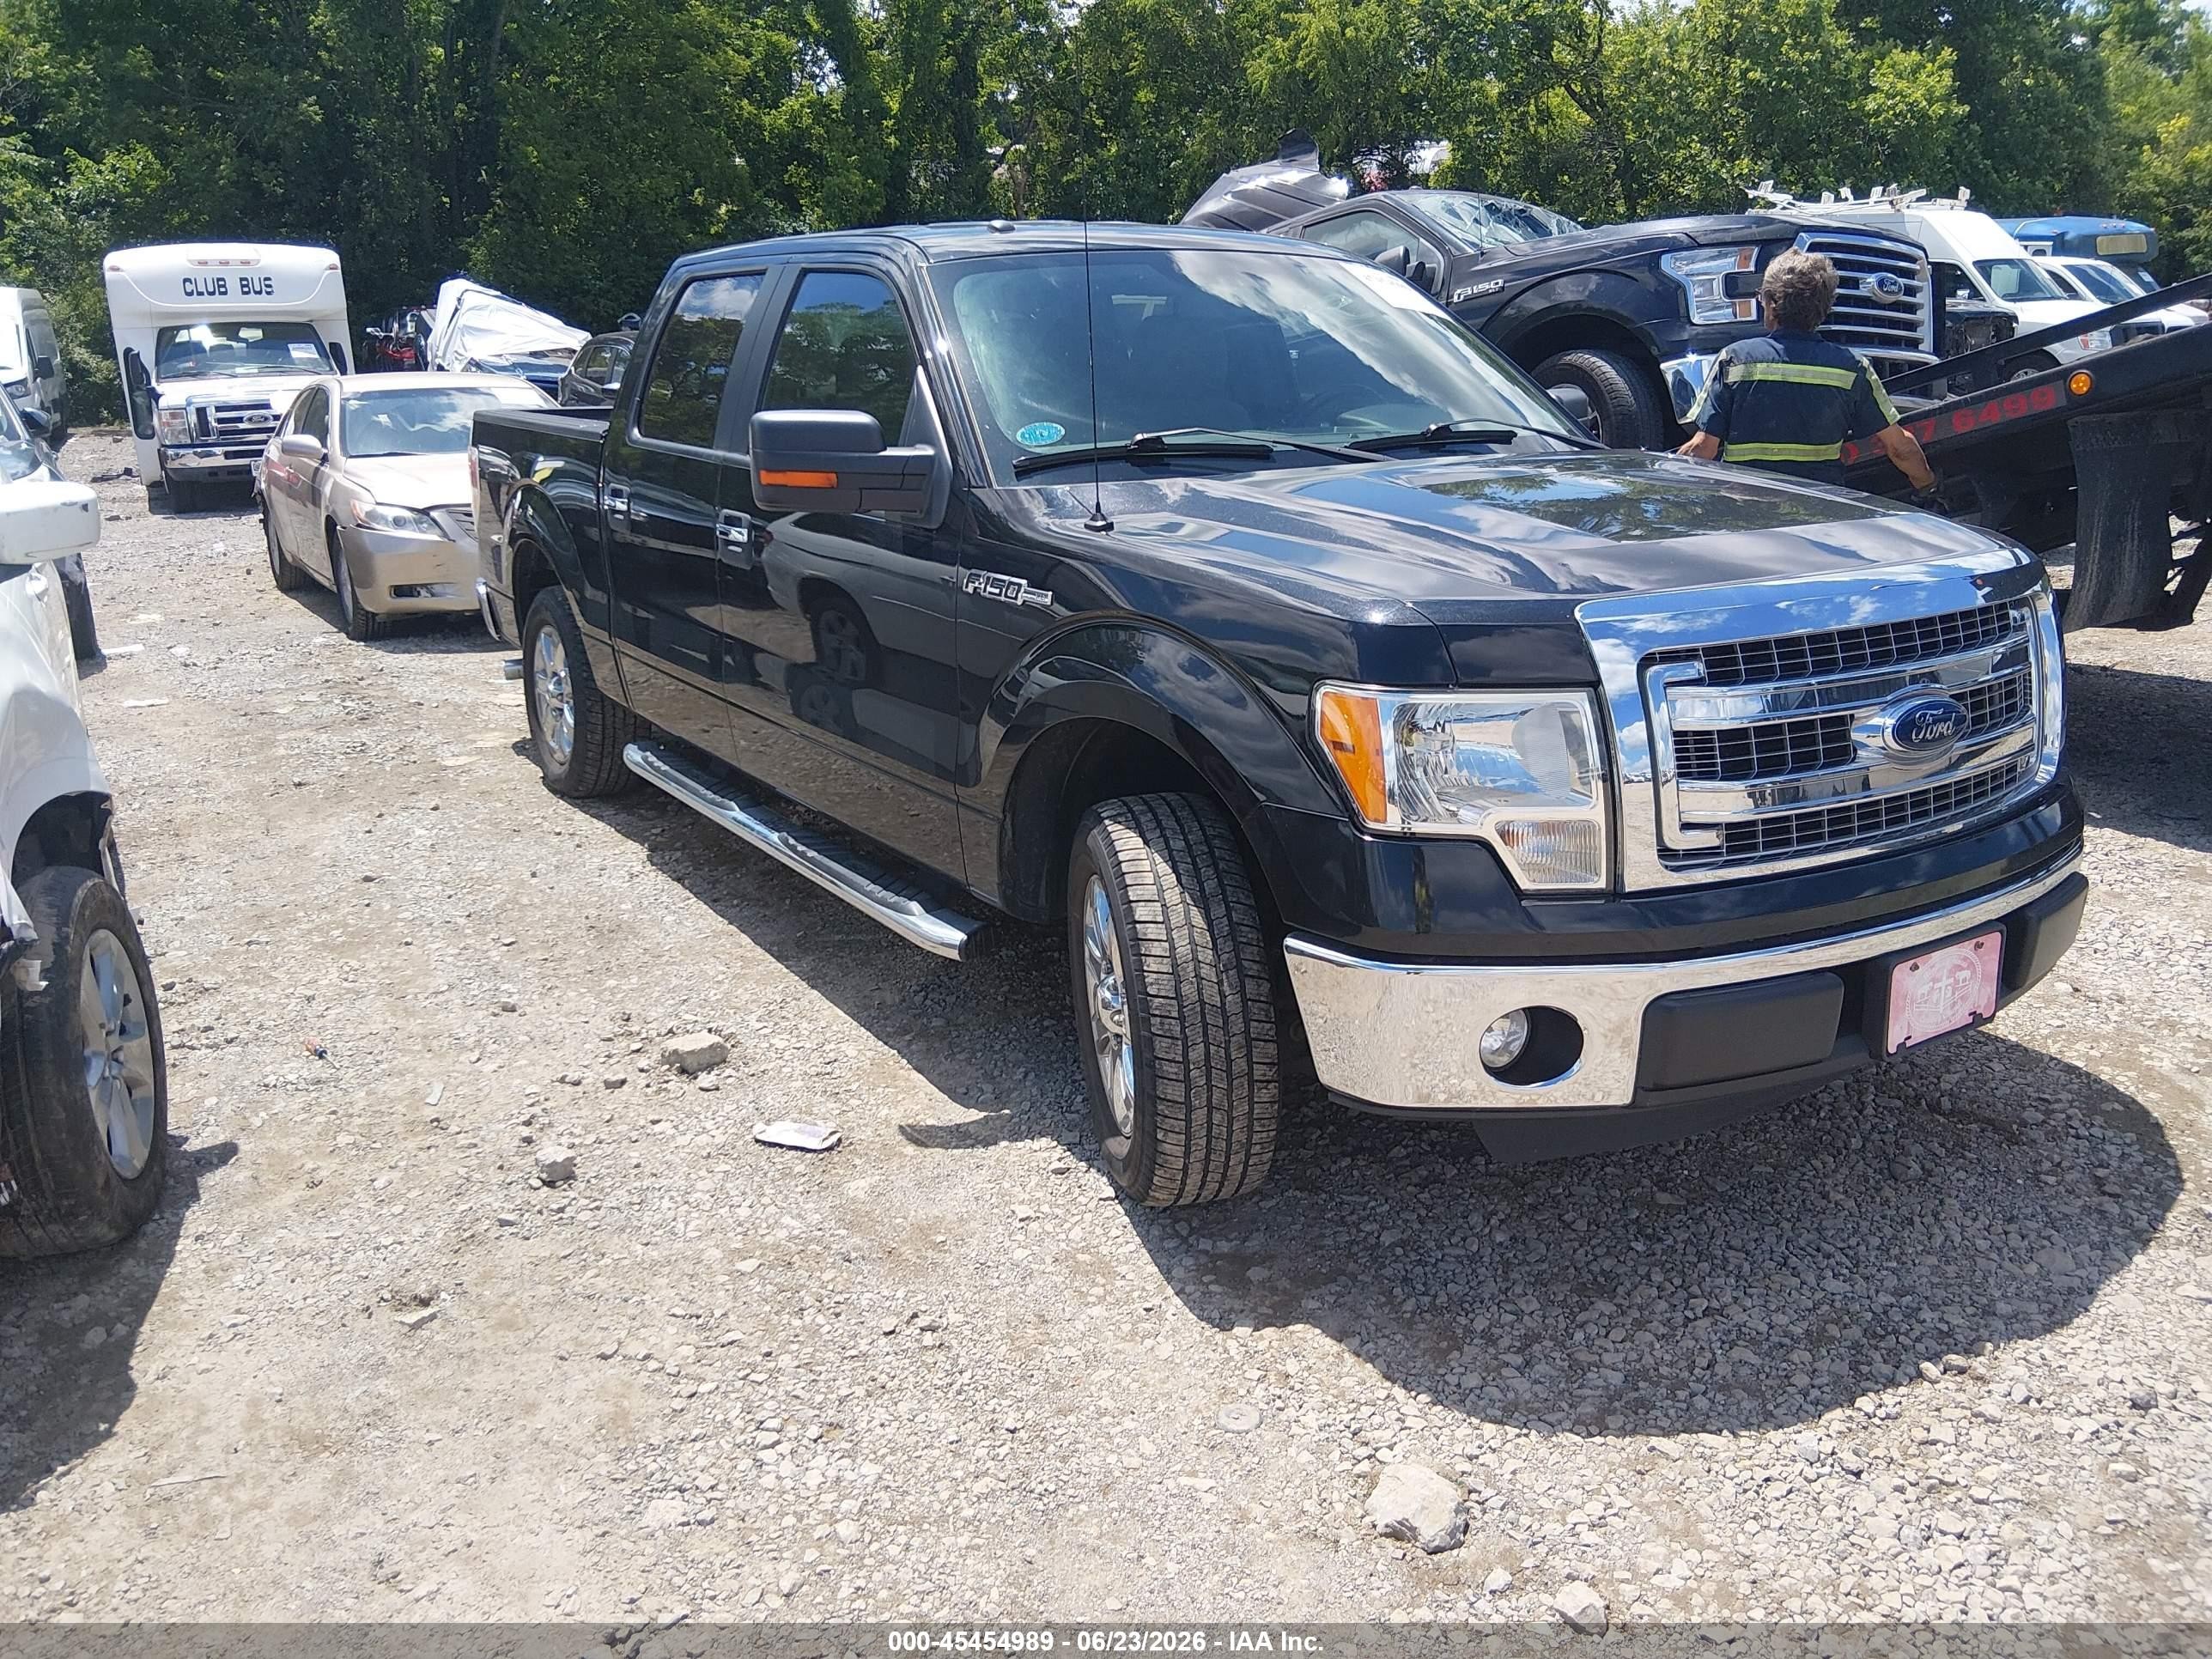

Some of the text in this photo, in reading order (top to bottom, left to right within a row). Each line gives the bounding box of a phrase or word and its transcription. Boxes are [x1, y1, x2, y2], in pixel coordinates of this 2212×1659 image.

[182, 276, 275, 296] CLUB BUS
[1882, 278, 1899, 293] Ford
[1952, 385, 2057, 434] 6499
[1911, 707, 1956, 743] Ford
